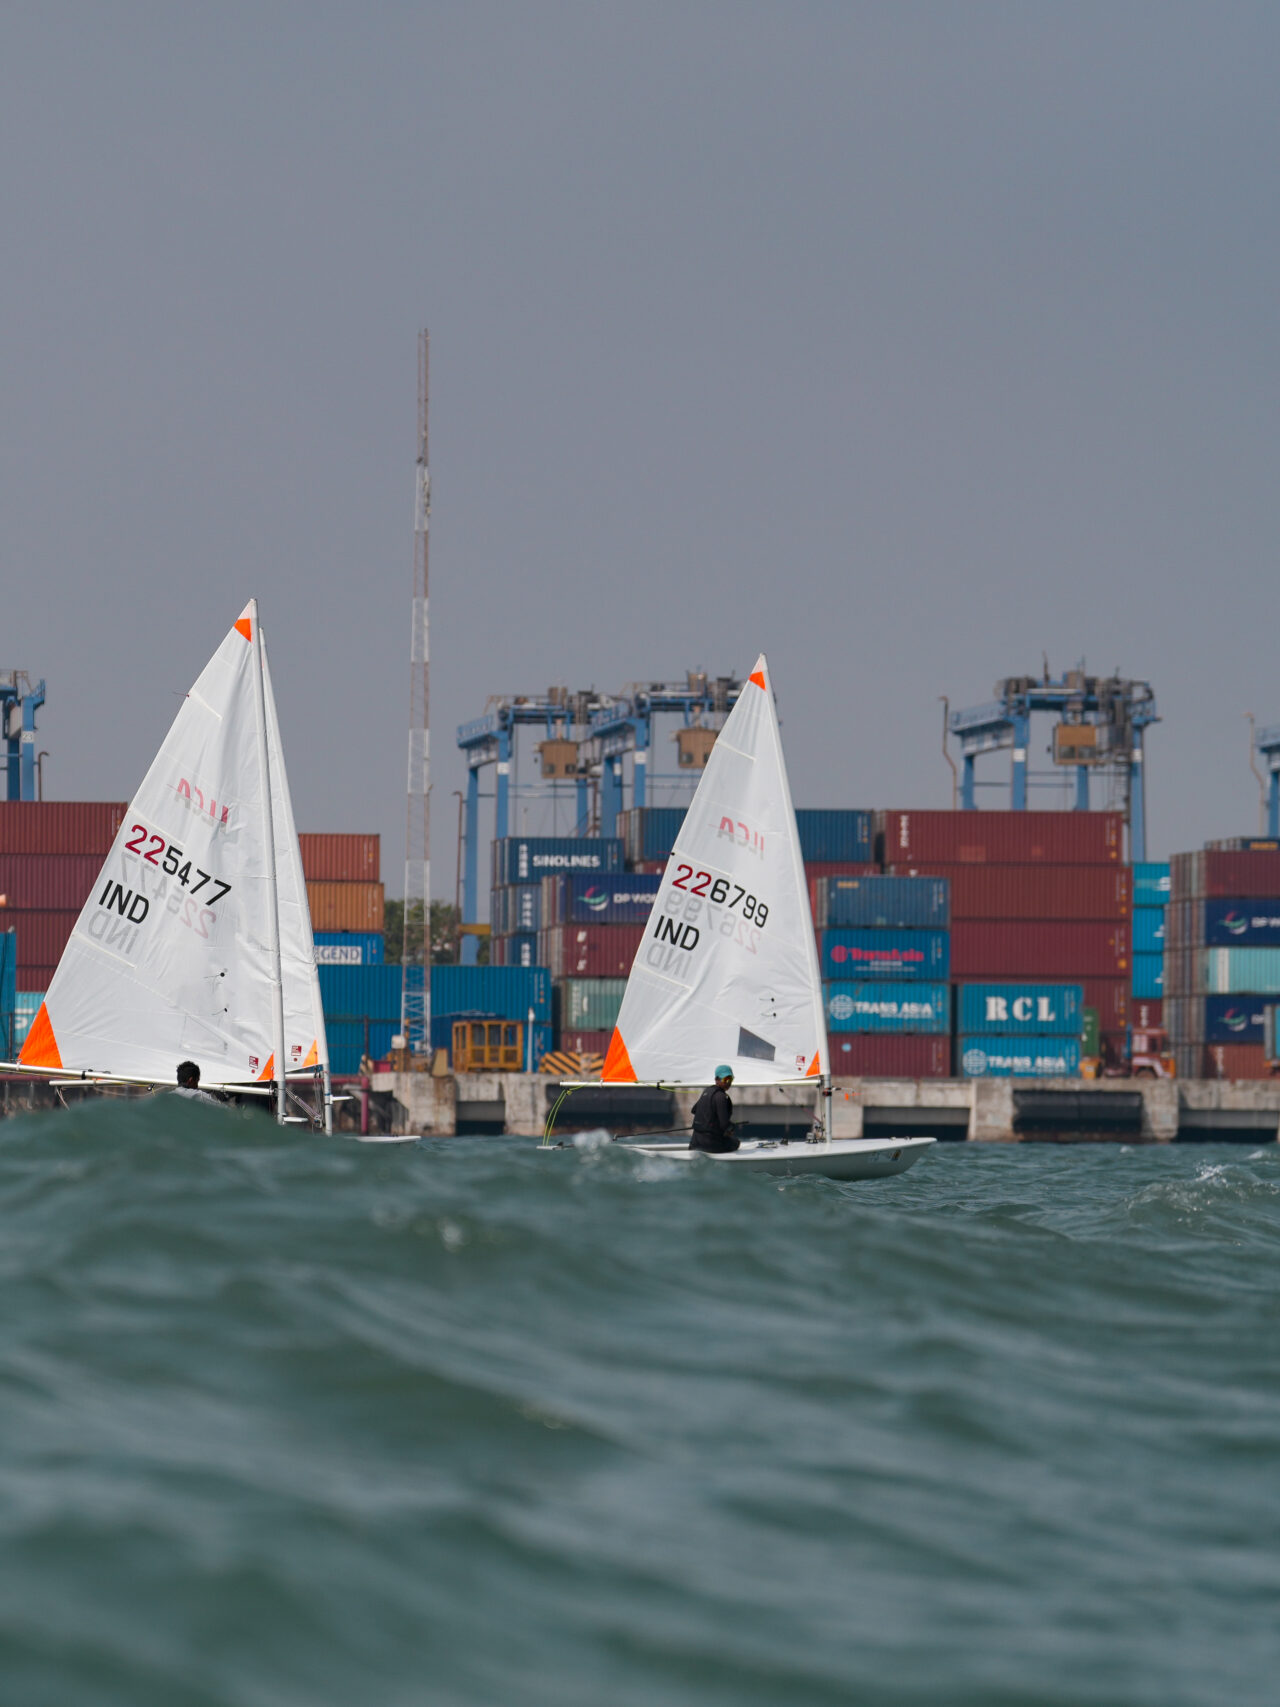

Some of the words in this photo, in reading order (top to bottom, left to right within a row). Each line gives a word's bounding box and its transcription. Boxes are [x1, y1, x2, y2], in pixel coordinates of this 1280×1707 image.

[124, 824, 232, 906] 225477
[98, 879, 150, 924] IND
[672, 864, 769, 928] 226799
[653, 915, 700, 951] IND
[855, 1002, 898, 1014] TRANS
[985, 996, 1056, 1021] RCL
[988, 1056, 1031, 1068] TRANS
[1035, 1056, 1066, 1068] ASIA
